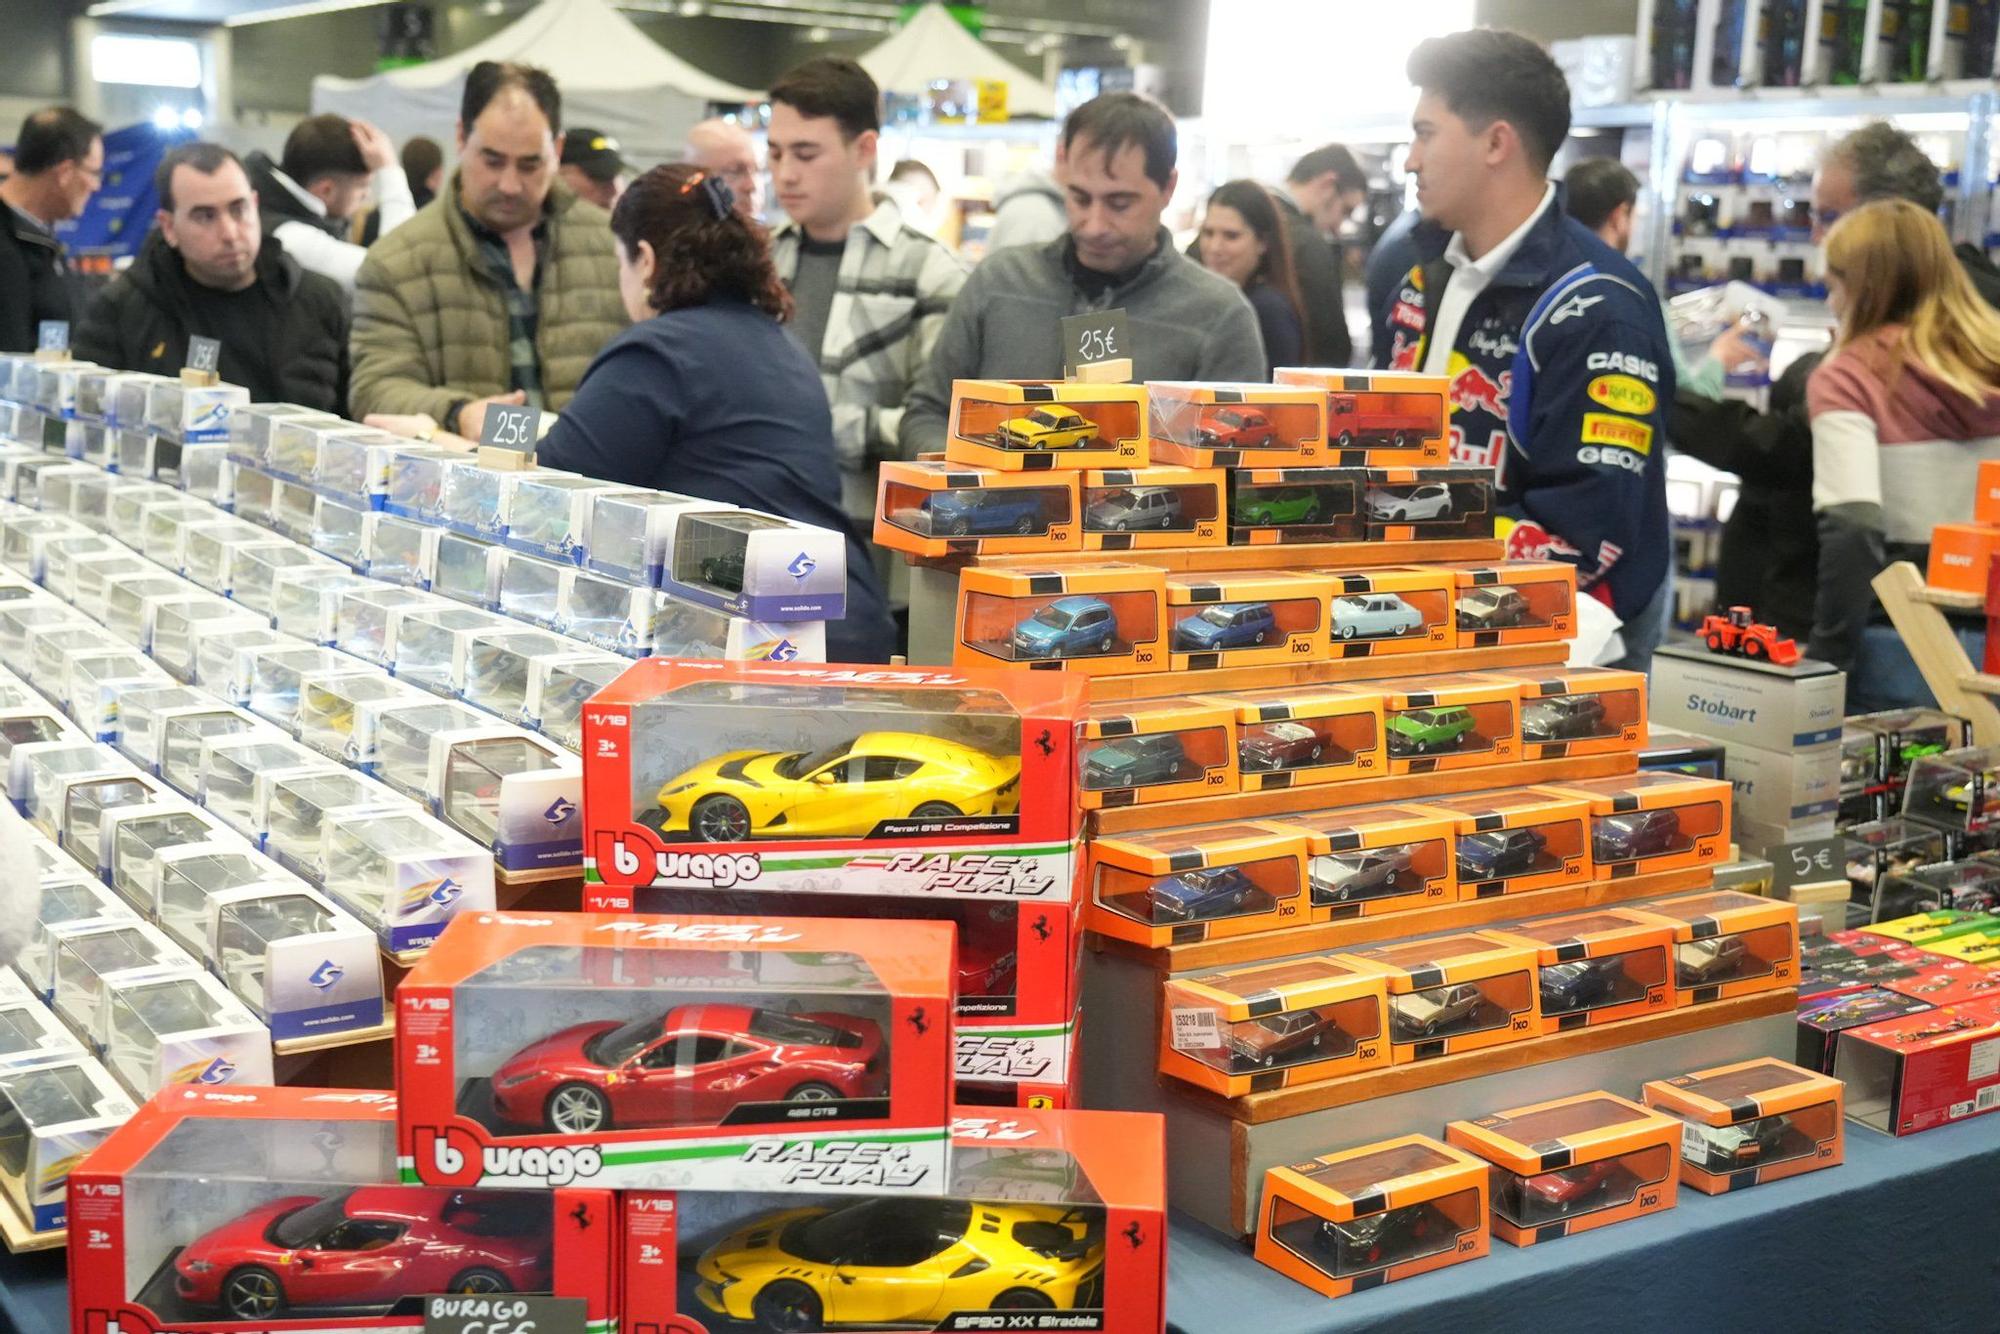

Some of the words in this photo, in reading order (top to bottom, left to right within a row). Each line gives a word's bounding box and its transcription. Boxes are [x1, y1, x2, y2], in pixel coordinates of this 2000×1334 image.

[1079, 327, 1118, 360] 25€
[493, 410, 532, 444] 25€
[1119, 444, 1136, 456] ixo
[1301, 444, 1315, 456] ixo
[1051, 528, 1067, 541] ixo
[1198, 524, 1213, 538] ixo
[1430, 630, 1445, 642] ixo
[1291, 640, 1310, 653] ixo
[1136, 650, 1153, 663] ixo
[1687, 694, 1757, 723] Stobart
[598, 739, 617, 751] 3+
[1357, 756, 1373, 768] ixo
[1207, 772, 1224, 785] ixo
[884, 823, 919, 833] Ferrari
[921, 823, 943, 832] 812
[944, 821, 1011, 832] Competizione
[1699, 844, 1714, 857] ixo
[1565, 864, 1580, 876] ixo
[920, 871, 1054, 896] PLAY
[1427, 884, 1443, 898] ixo
[1279, 903, 1296, 917] ixo
[1512, 1018, 1528, 1031] ixo
[417, 1045, 439, 1058] 3+
[1359, 1046, 1376, 1060] ixo
[782, 1162, 929, 1187] PLAY
[1640, 1193, 1658, 1208] ixo
[87, 1229, 110, 1243] 3+
[640, 1244, 662, 1258] 3+
[1459, 1239, 1475, 1253] ixo
[430, 1298, 528, 1320] BURAGO
[954, 1316, 1005, 1329] SF90
[1007, 1316, 1036, 1328] XX
[1038, 1315, 1099, 1328] Stradale
